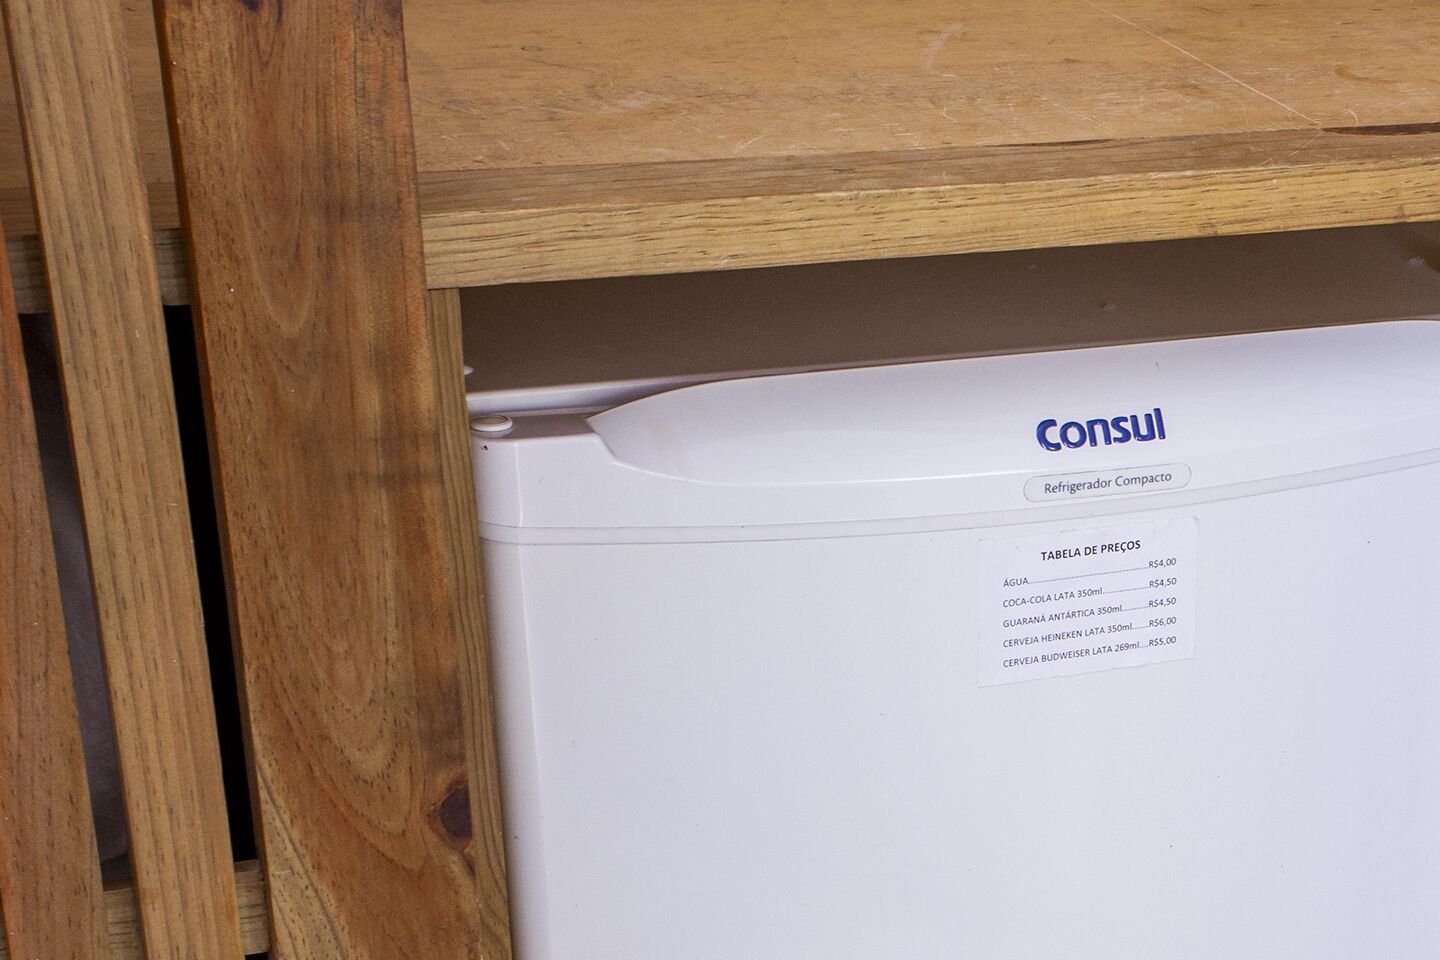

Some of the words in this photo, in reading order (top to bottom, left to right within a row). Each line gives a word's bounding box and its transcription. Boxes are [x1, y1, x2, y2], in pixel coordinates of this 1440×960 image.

[1036, 408, 1166, 452] Consul
[1044, 478, 1112, 494] Refrigerador
[1115, 472, 1172, 488] Compacto
[1041, 548, 1081, 561] TABELA
[1084, 546, 1098, 556] DE
[1101, 540, 1141, 554] PREÇOS
[1003, 594, 1052, 608] COCA-COLA
[1054, 591, 1075, 600] LATA
[1003, 615, 1046, 628] GUARANÁ
[1048, 609, 1095, 621] ANTÁRTICA
[1003, 636, 1039, 648] CERVEJA
[1042, 630, 1082, 642] HEINEKEN
[1085, 627, 1105, 636] LATA
[1003, 655, 1039, 668] CERVEJA
[1042, 649, 1090, 662] BUDWEISER
[1092, 645, 1112, 655] LATA
